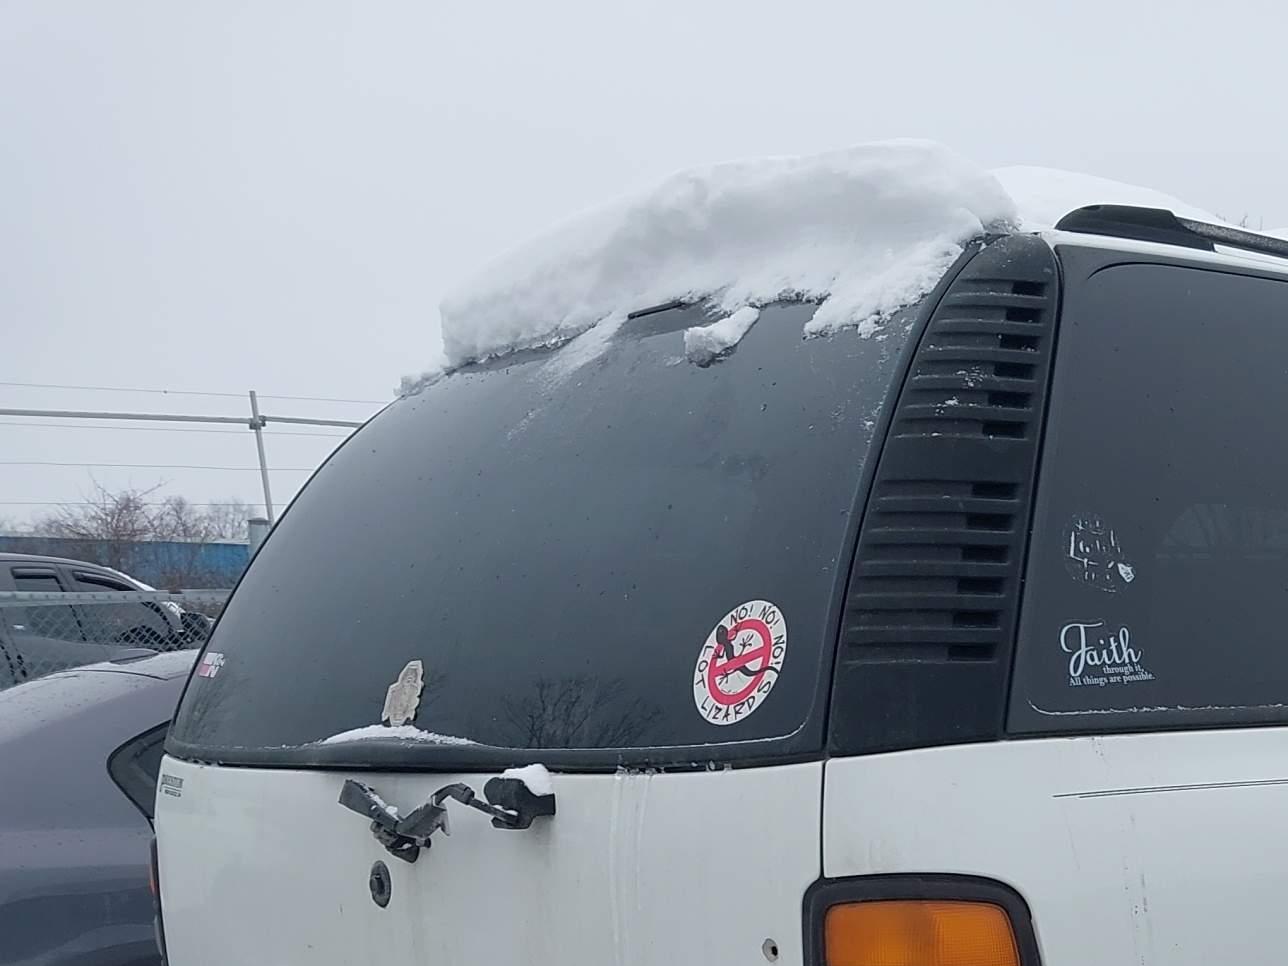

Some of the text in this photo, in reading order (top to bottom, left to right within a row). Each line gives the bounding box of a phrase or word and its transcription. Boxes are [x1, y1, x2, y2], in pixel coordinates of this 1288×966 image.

[729, 604, 785, 666] NO! NO! NO!
[1060, 622, 1142, 677] Faith
[695, 645, 772, 722] LOT LIZARDS
[1069, 671, 1156, 687] All things are possible.
[1102, 664, 1134, 676] through
